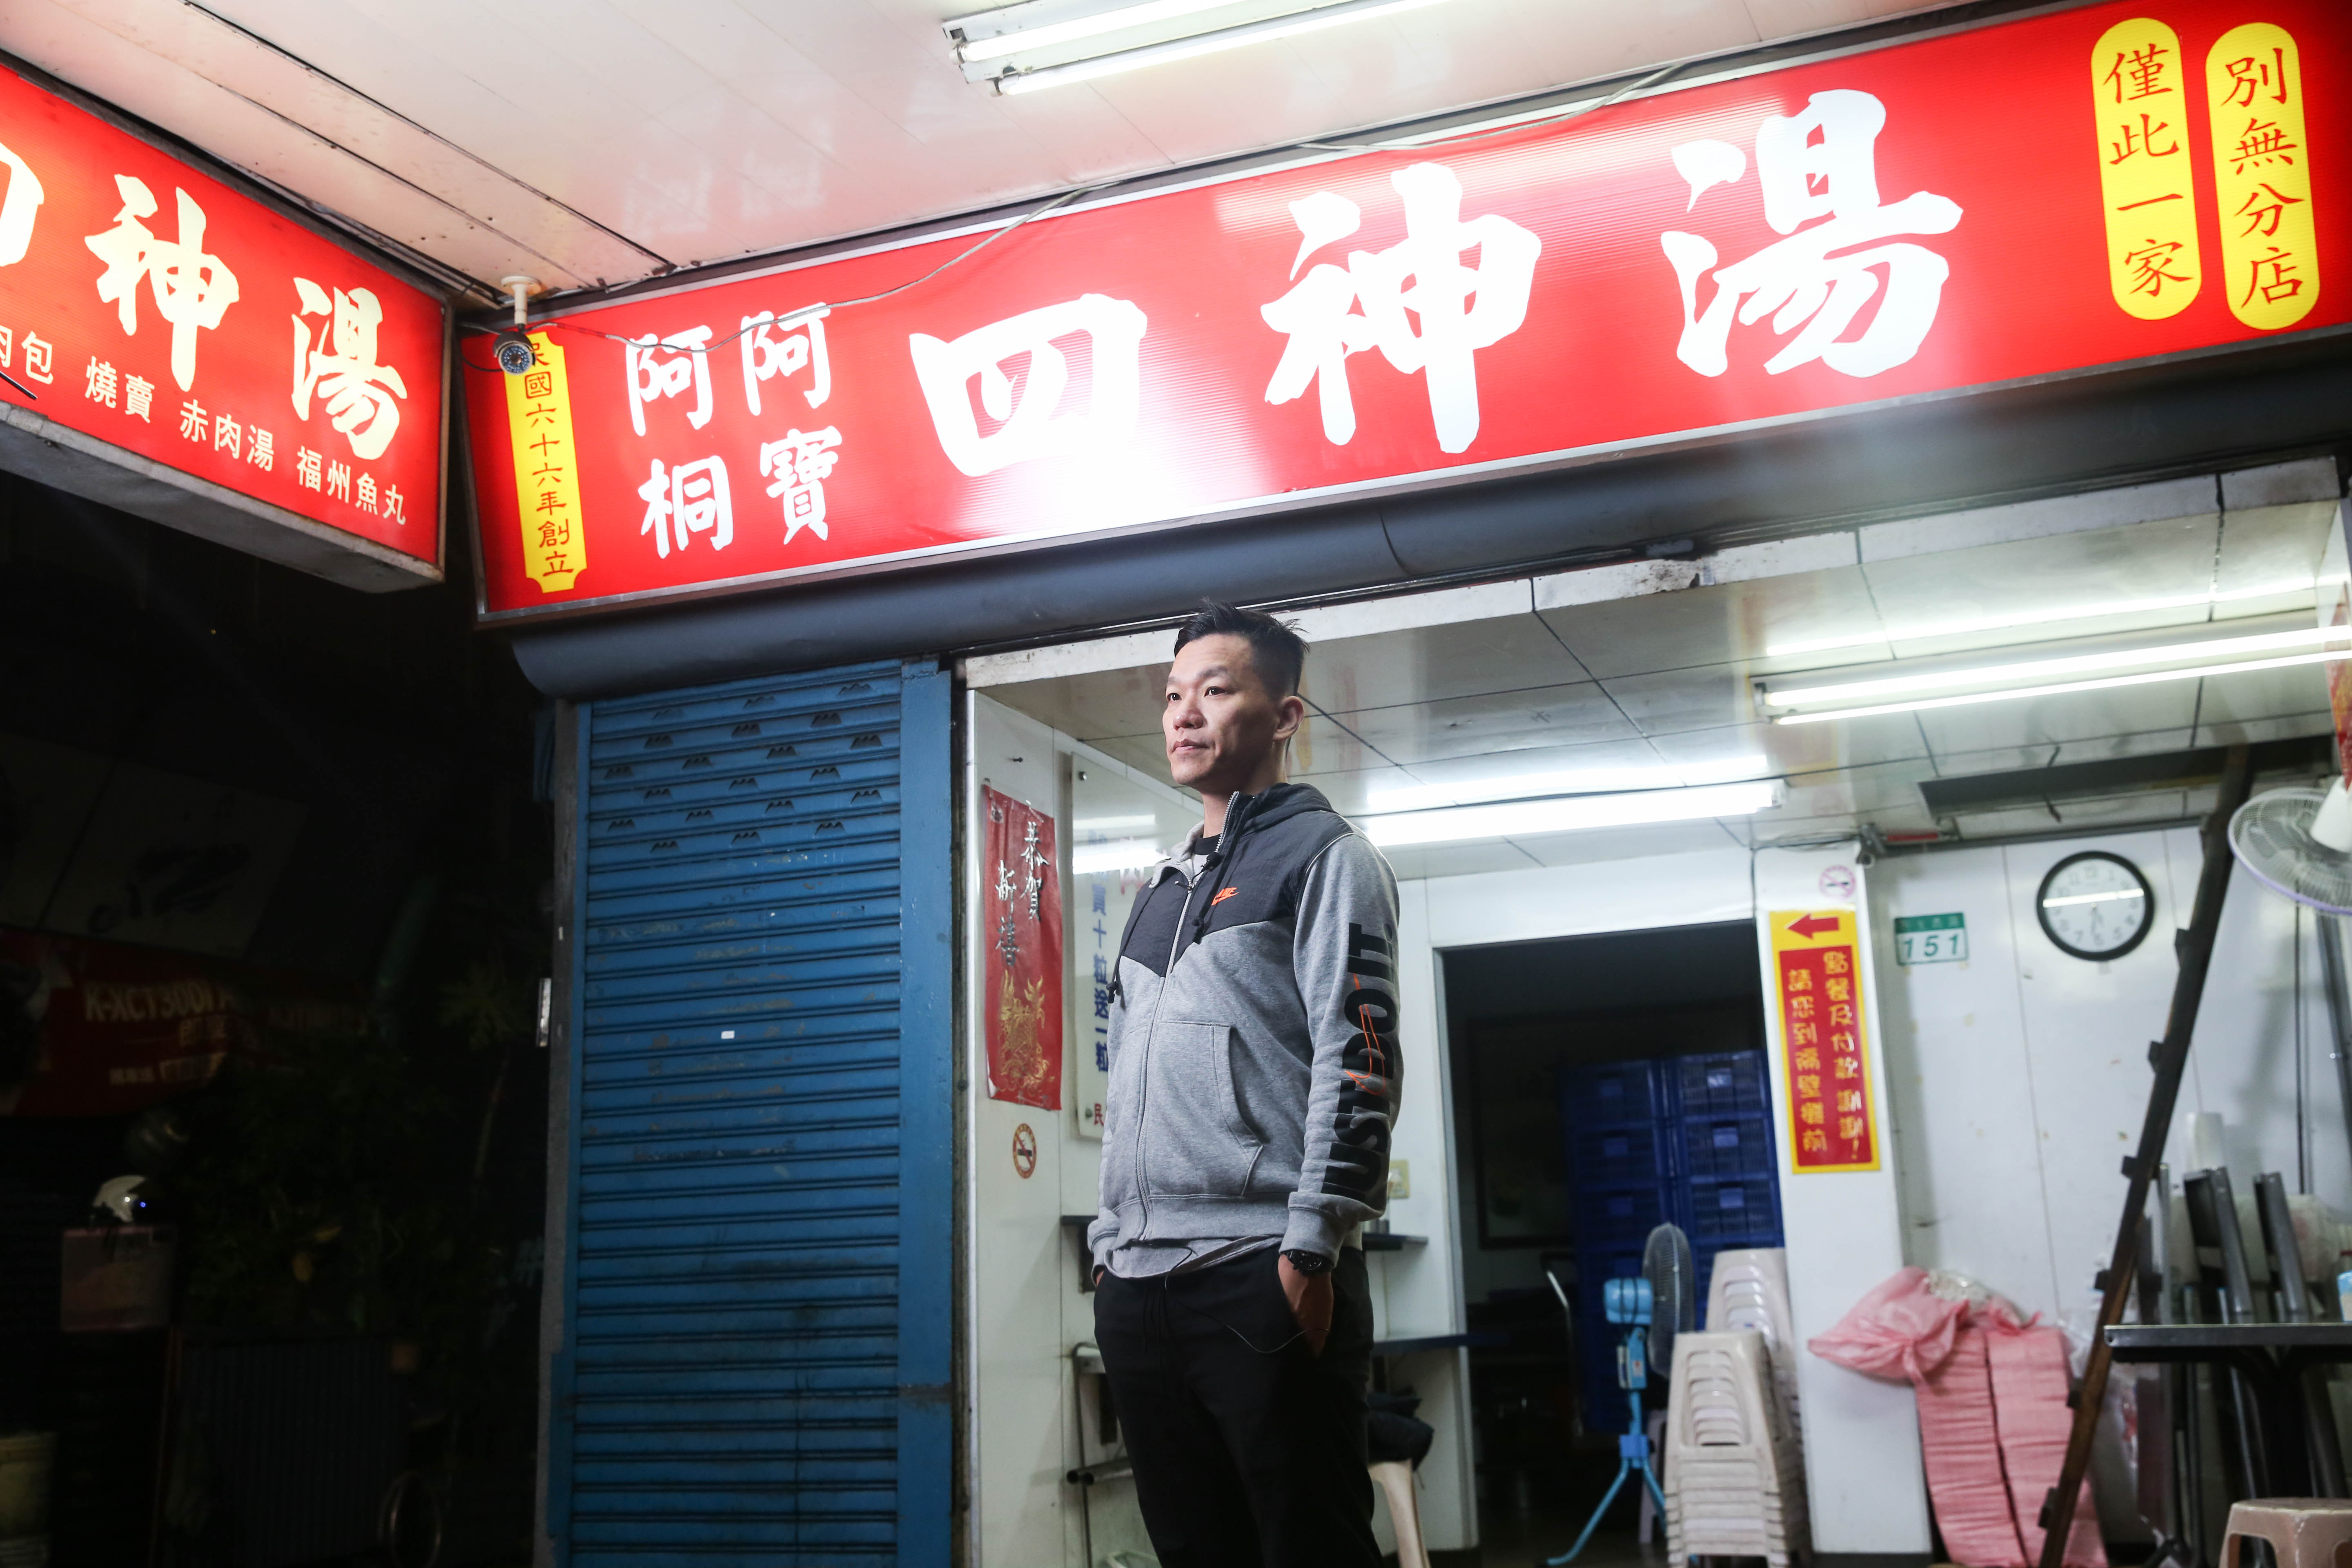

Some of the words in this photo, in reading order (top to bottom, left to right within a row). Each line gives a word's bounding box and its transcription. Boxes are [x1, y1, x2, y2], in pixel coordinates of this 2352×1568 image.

[2103, 43, 2194, 297] 僅此一家
[2221, 48, 2304, 309] 別無分店
[910, 89, 1963, 477] 四神湯
[85, 356, 155, 423] 燒賣
[180, 399, 275, 472] 赤肉湯
[297, 446, 406, 525] 福州魚丸
[1348, 923, 1394, 981] IT
[1904, 934, 1958, 958] 151
[1342, 988, 1396, 1080] DO
